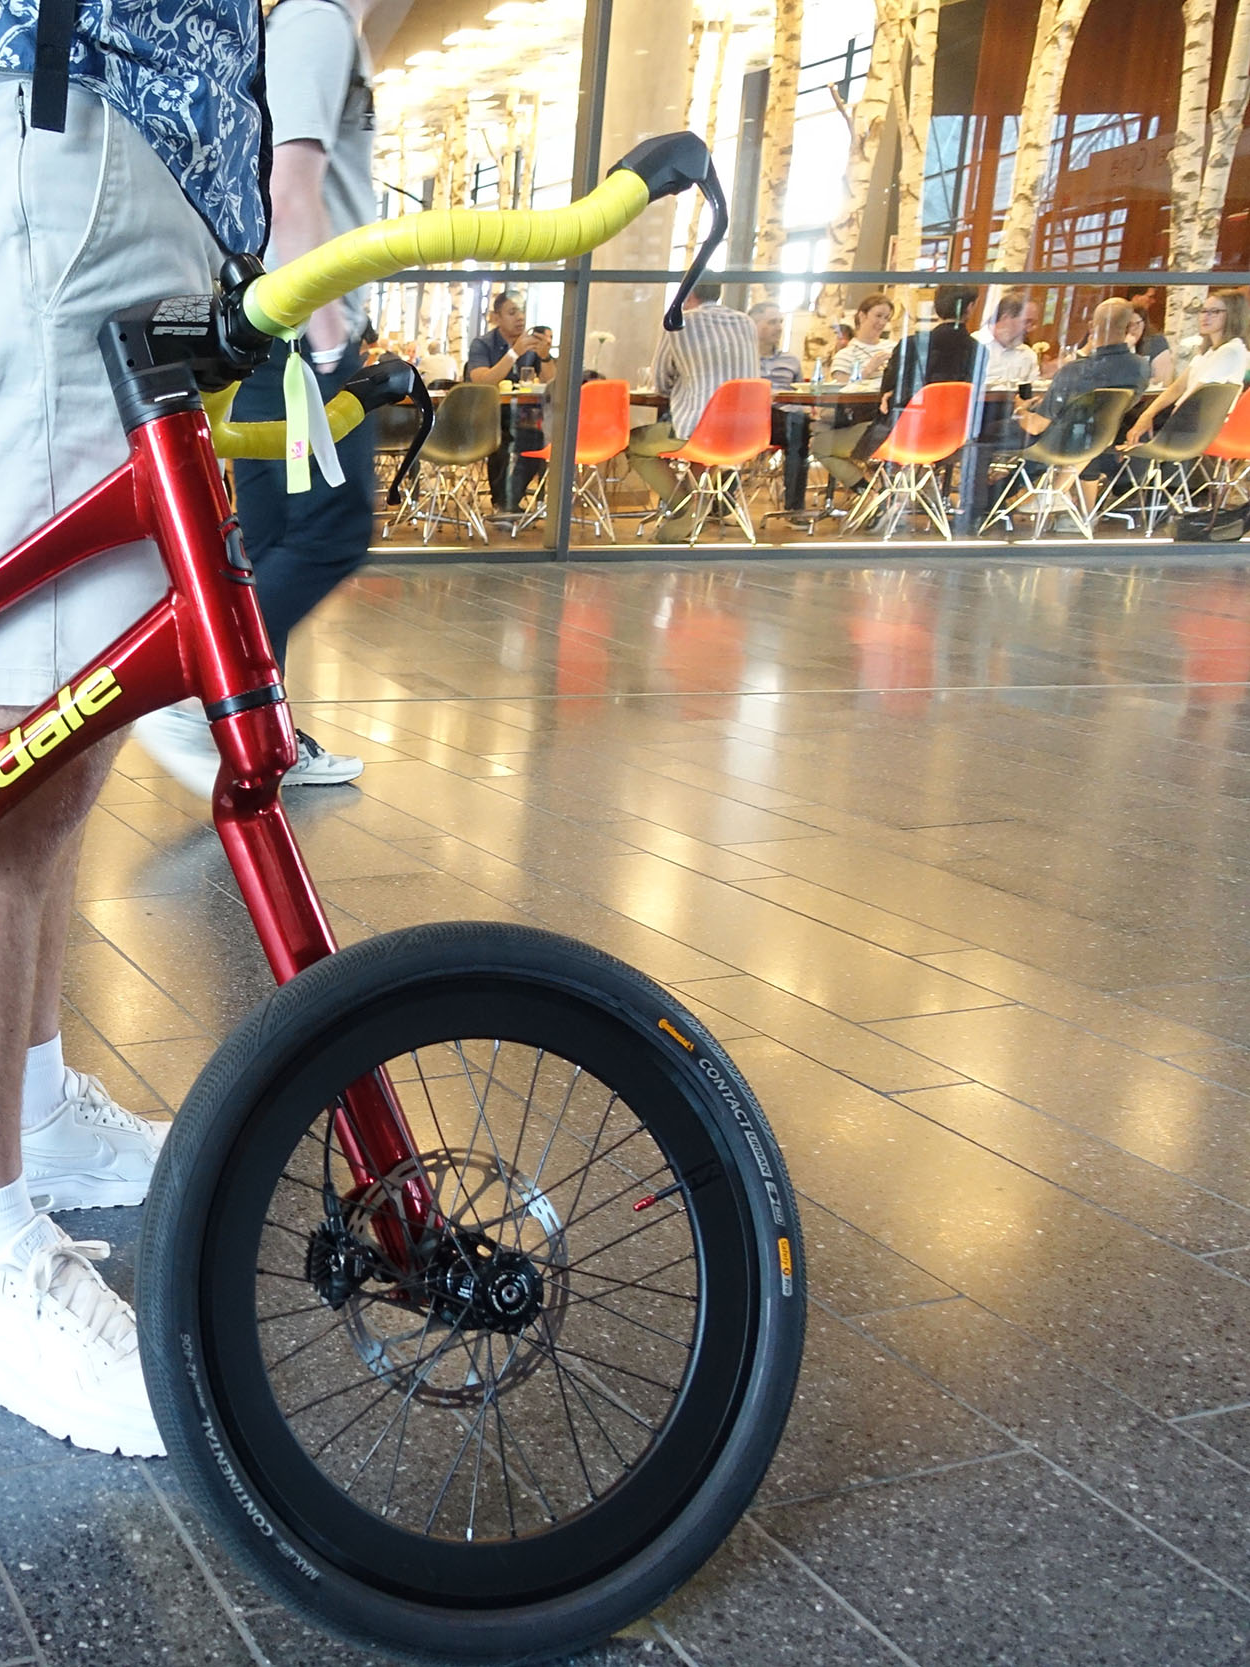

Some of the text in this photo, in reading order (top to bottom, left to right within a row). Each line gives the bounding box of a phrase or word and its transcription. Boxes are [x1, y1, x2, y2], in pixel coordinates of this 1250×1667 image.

[698, 1058, 753, 1132] CONTACT
[746, 1131, 772, 1177] URBAN
[202, 1415, 274, 1537] CONTINENTAL
